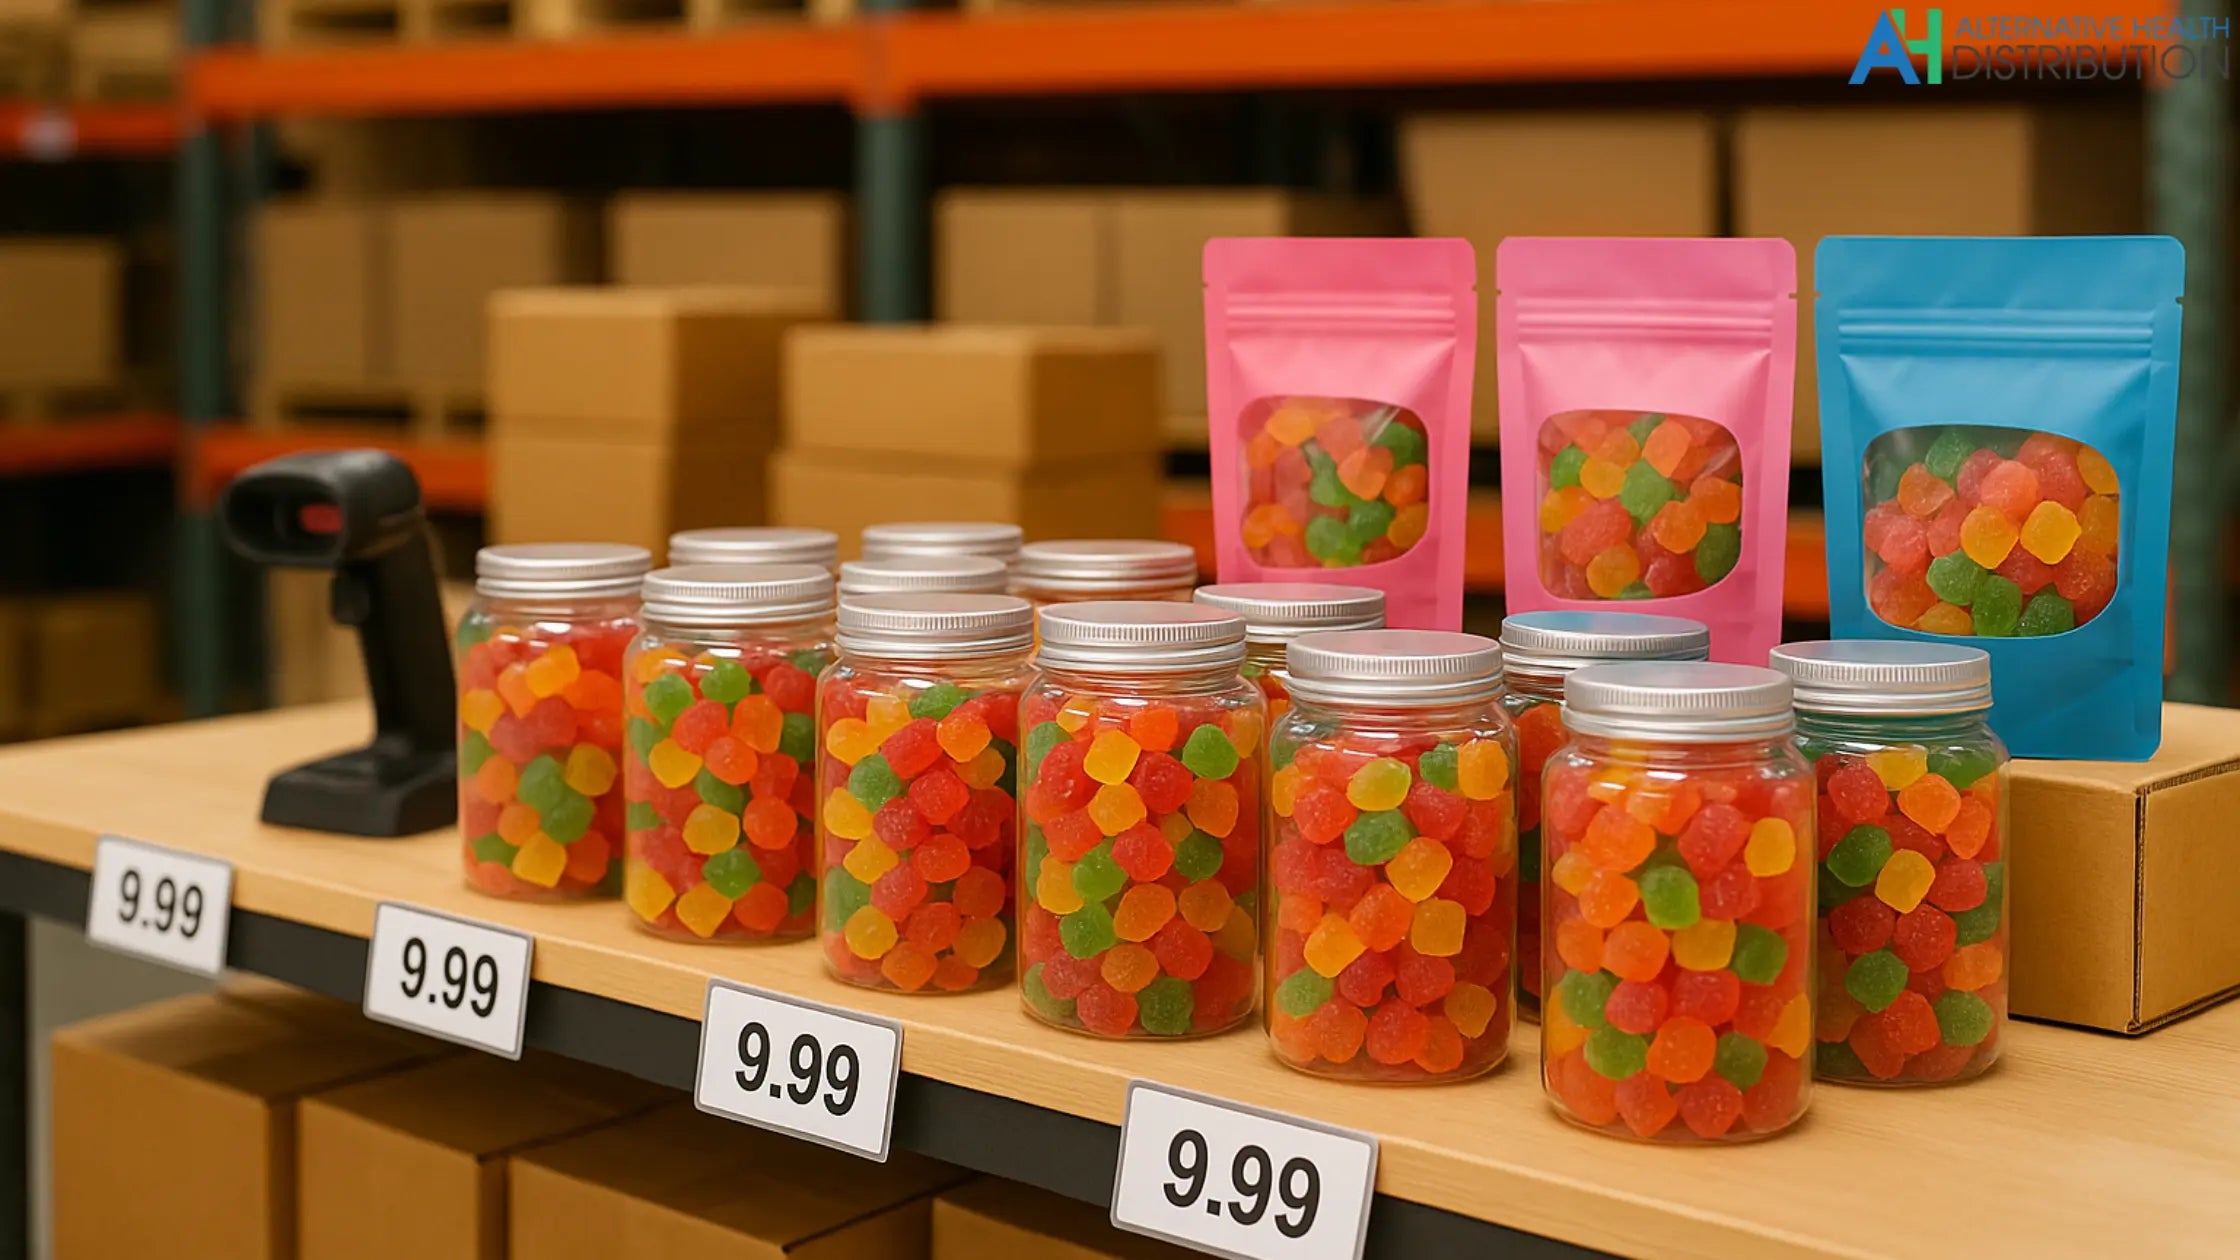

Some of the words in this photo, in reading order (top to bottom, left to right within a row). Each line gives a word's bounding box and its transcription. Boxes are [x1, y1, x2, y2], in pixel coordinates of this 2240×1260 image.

[120, 870, 202, 938] 9.99
[401, 938, 498, 1018] 9.99
[736, 1022, 859, 1116] 9.99
[1164, 1130, 1320, 1238] 9.99
